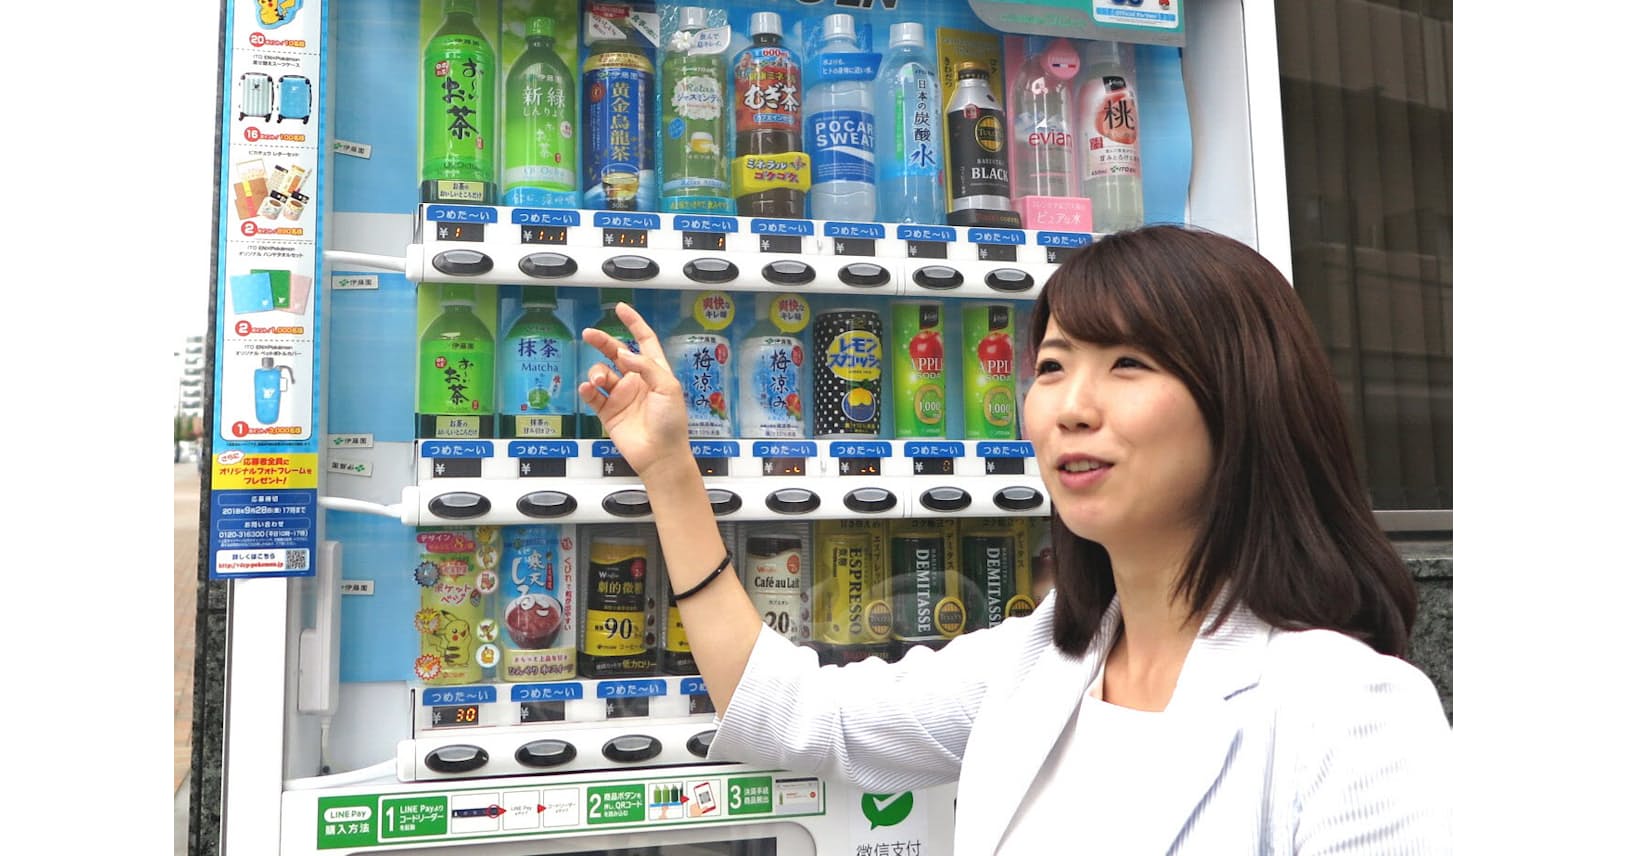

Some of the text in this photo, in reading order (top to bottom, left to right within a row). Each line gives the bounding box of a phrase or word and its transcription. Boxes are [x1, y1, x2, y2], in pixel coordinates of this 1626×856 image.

[744, 82, 800, 112] むぎ茶
[610, 82, 630, 161] 黄金烏龍茶
[911, 79, 936, 168] 日本の炭酸水
[1103, 99, 1136, 130] 桃
[1028, 128, 1073, 149] evian
[971, 167, 1009, 183] BLACK
[244, 223, 255, 234] 2
[238, 323, 249, 334] 2
[518, 338, 559, 358] 抹茶
[838, 337, 878, 353] レモン
[521, 362, 559, 372] Matcha
[444, 366, 470, 406] お茶
[237, 423, 243, 433] 1
[754, 576, 775, 588] Café
[775, 579, 786, 588] au
[848, 546, 863, 636] ESPRESSO
[916, 549, 932, 633] DEMITASSE
[604, 617, 633, 640] 90
[589, 793, 602, 819] 2
[729, 784, 742, 810] 3
[330, 811, 350, 820] LINE
[385, 806, 395, 832] 1
[399, 805, 419, 814] LINE
[399, 812, 444, 824] コードリーダー
[856, 839, 922, 856] 微信支付
